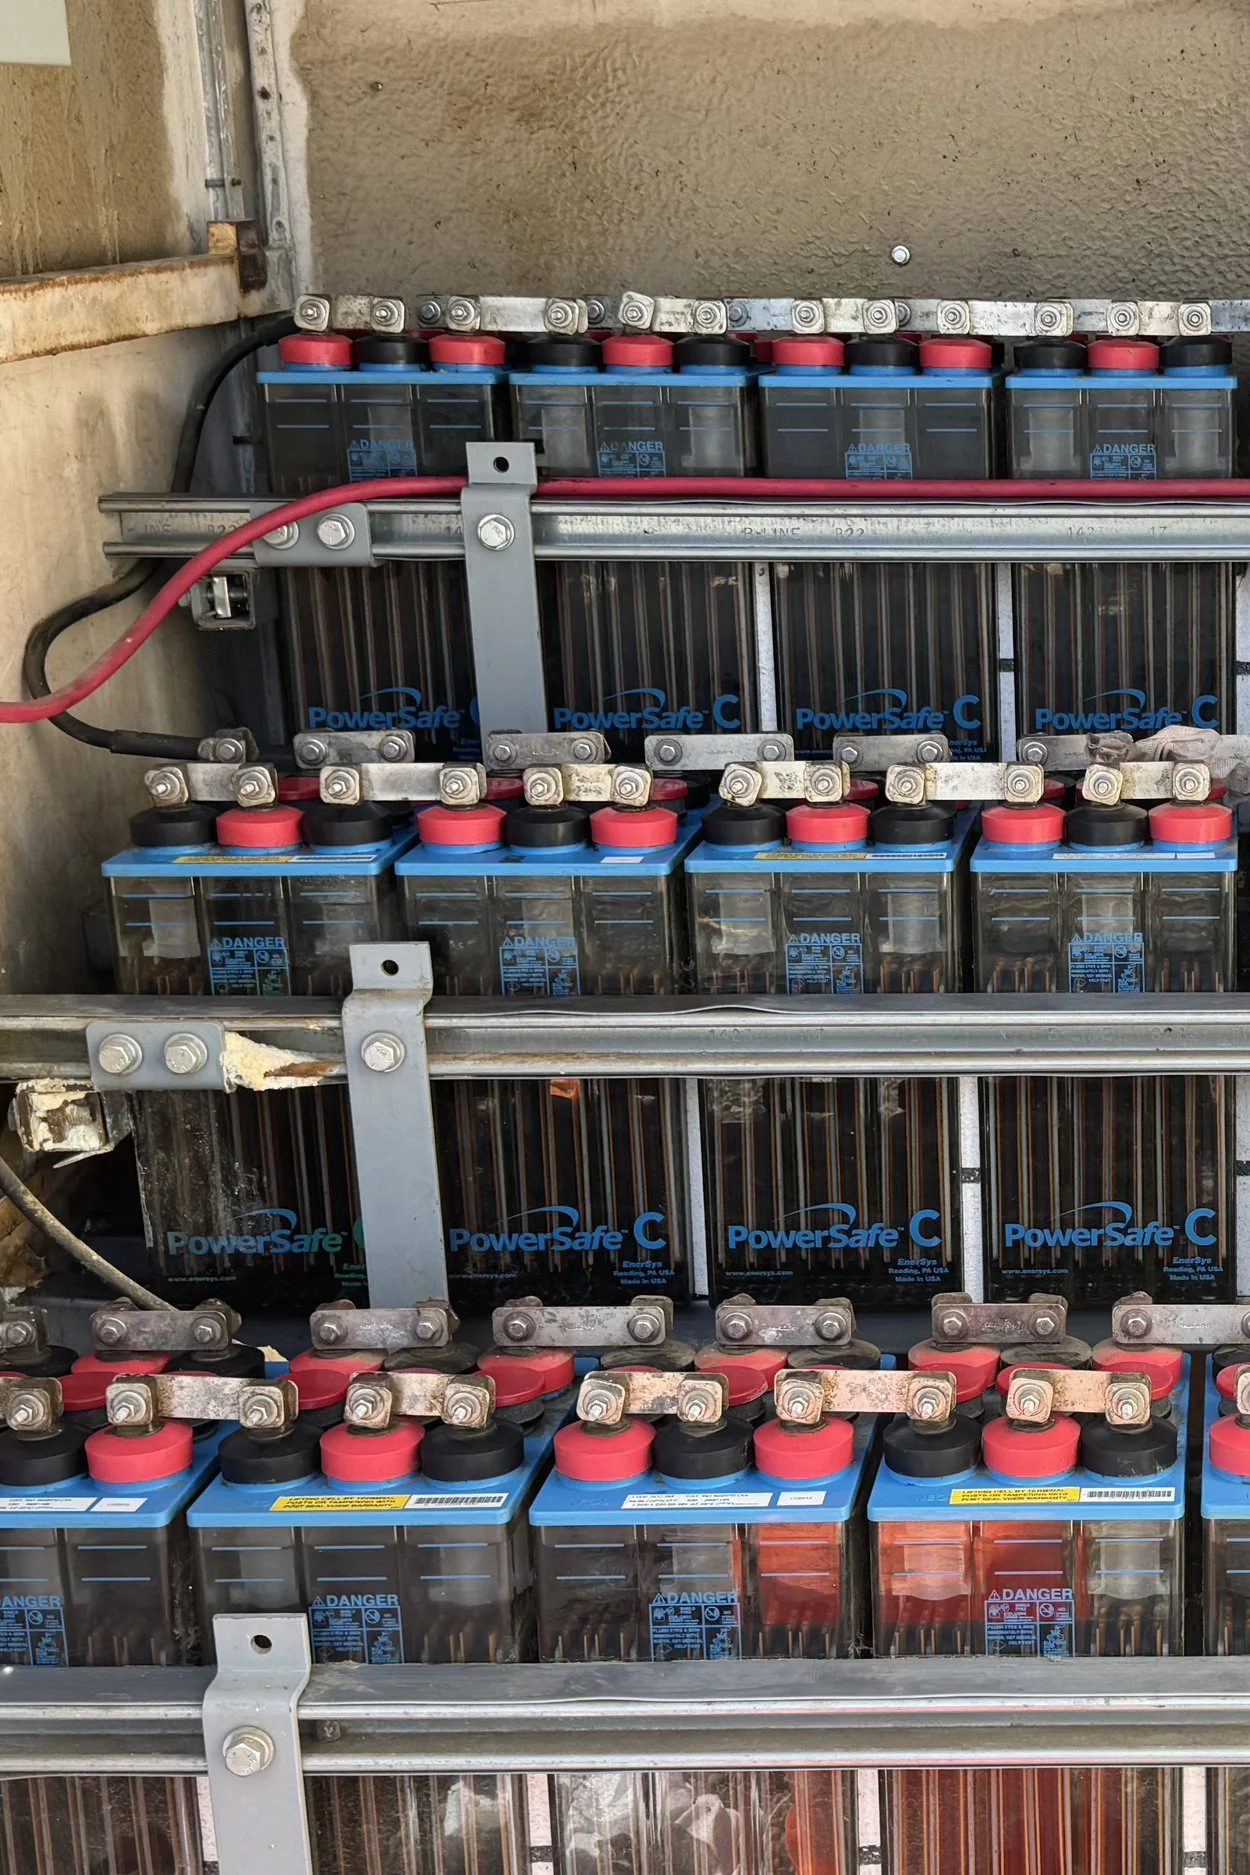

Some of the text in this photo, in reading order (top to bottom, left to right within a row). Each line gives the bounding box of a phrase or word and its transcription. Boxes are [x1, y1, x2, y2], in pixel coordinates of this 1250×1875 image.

[611, 441, 664, 451] DANGER
[858, 443, 911, 453] DANGER
[1103, 444, 1155, 453] DANGER
[713, 694, 740, 729] C
[953, 694, 981, 730] C
[1191, 694, 1218, 729] C
[222, 936, 286, 948] DANGER
[513, 936, 577, 948] DANGER
[799, 932, 861, 944] DANGER
[1081, 932, 1144, 943] DANGER
[634, 1211, 667, 1250] C
[908, 1208, 942, 1248] C
[1184, 1207, 1217, 1245] C
[897, 1258, 937, 1266] EnerSys
[1172, 1256, 1212, 1265] EnerSys
[326, 1594, 398, 1606] DANGER
[667, 1592, 739, 1603] DANGER
[1002, 1588, 1073, 1600] DANGER
[0, 1595, 61, 1607] ANGER
